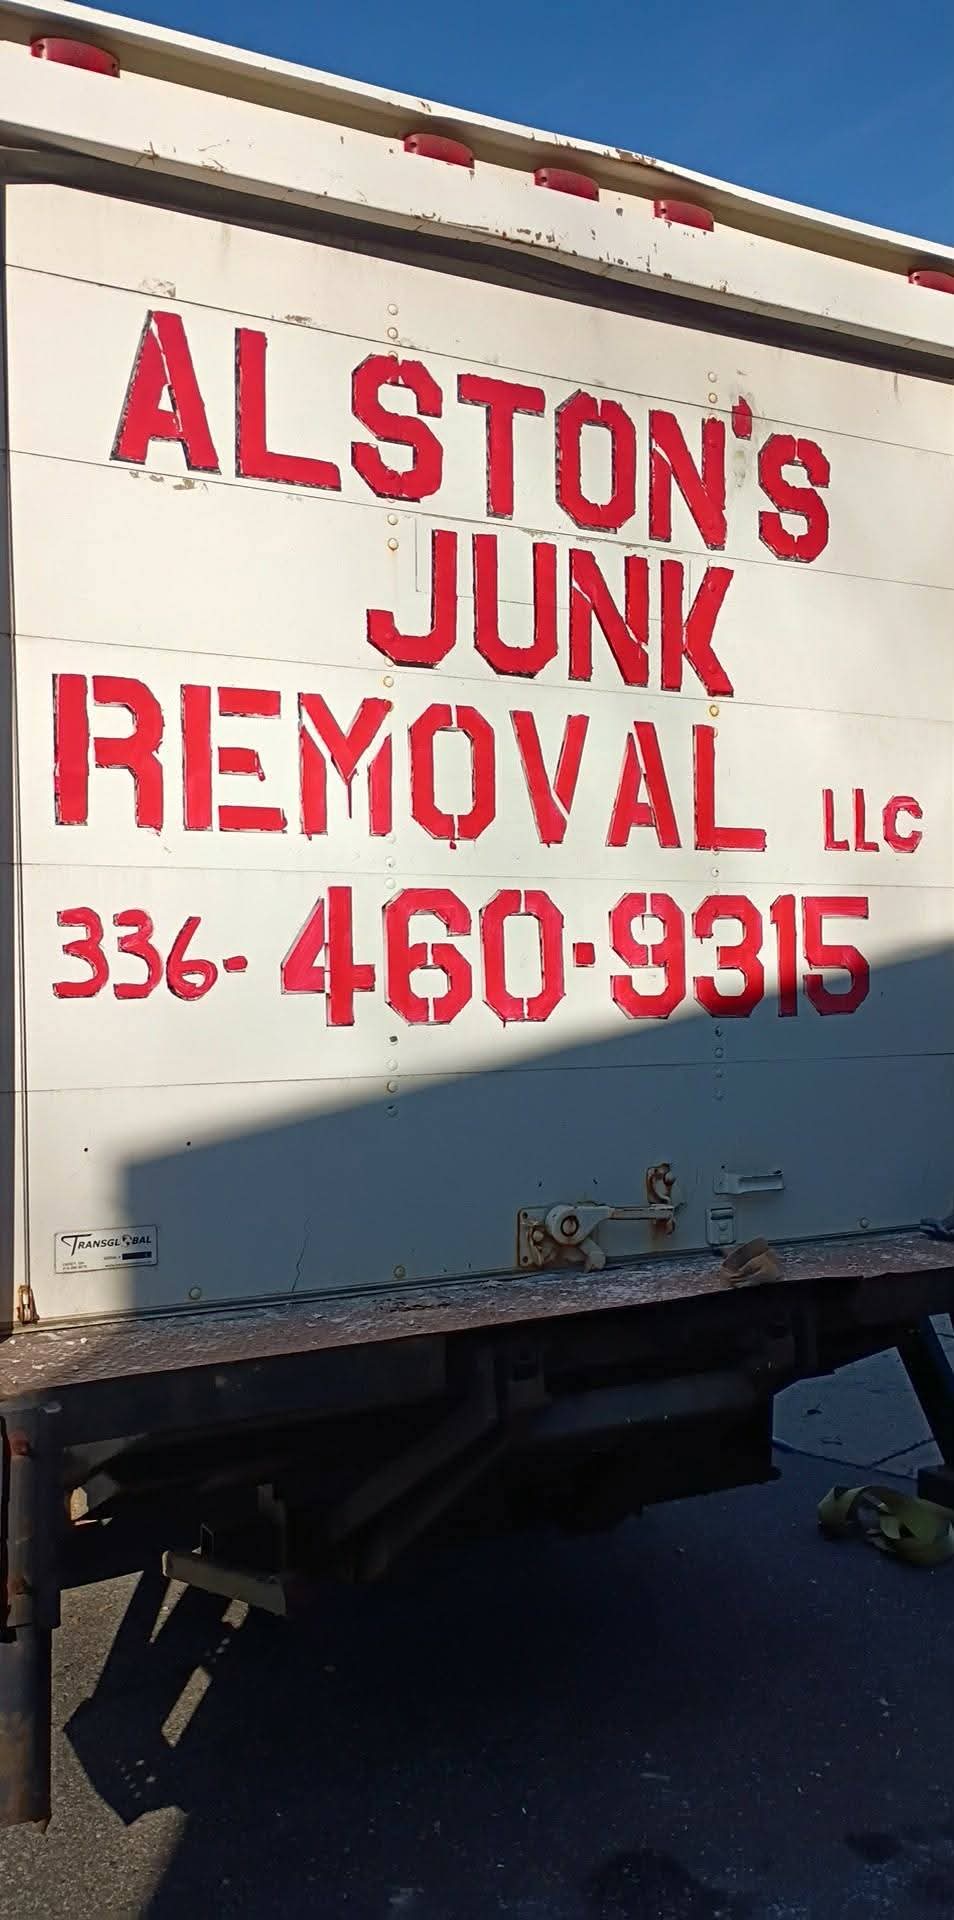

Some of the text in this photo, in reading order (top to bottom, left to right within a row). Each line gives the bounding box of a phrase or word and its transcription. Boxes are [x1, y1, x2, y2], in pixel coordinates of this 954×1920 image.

[112, 310, 831, 564] ALSTON'S
[366, 530, 734, 698] JUNK
[53, 673, 923, 854] REMOVAL LLC
